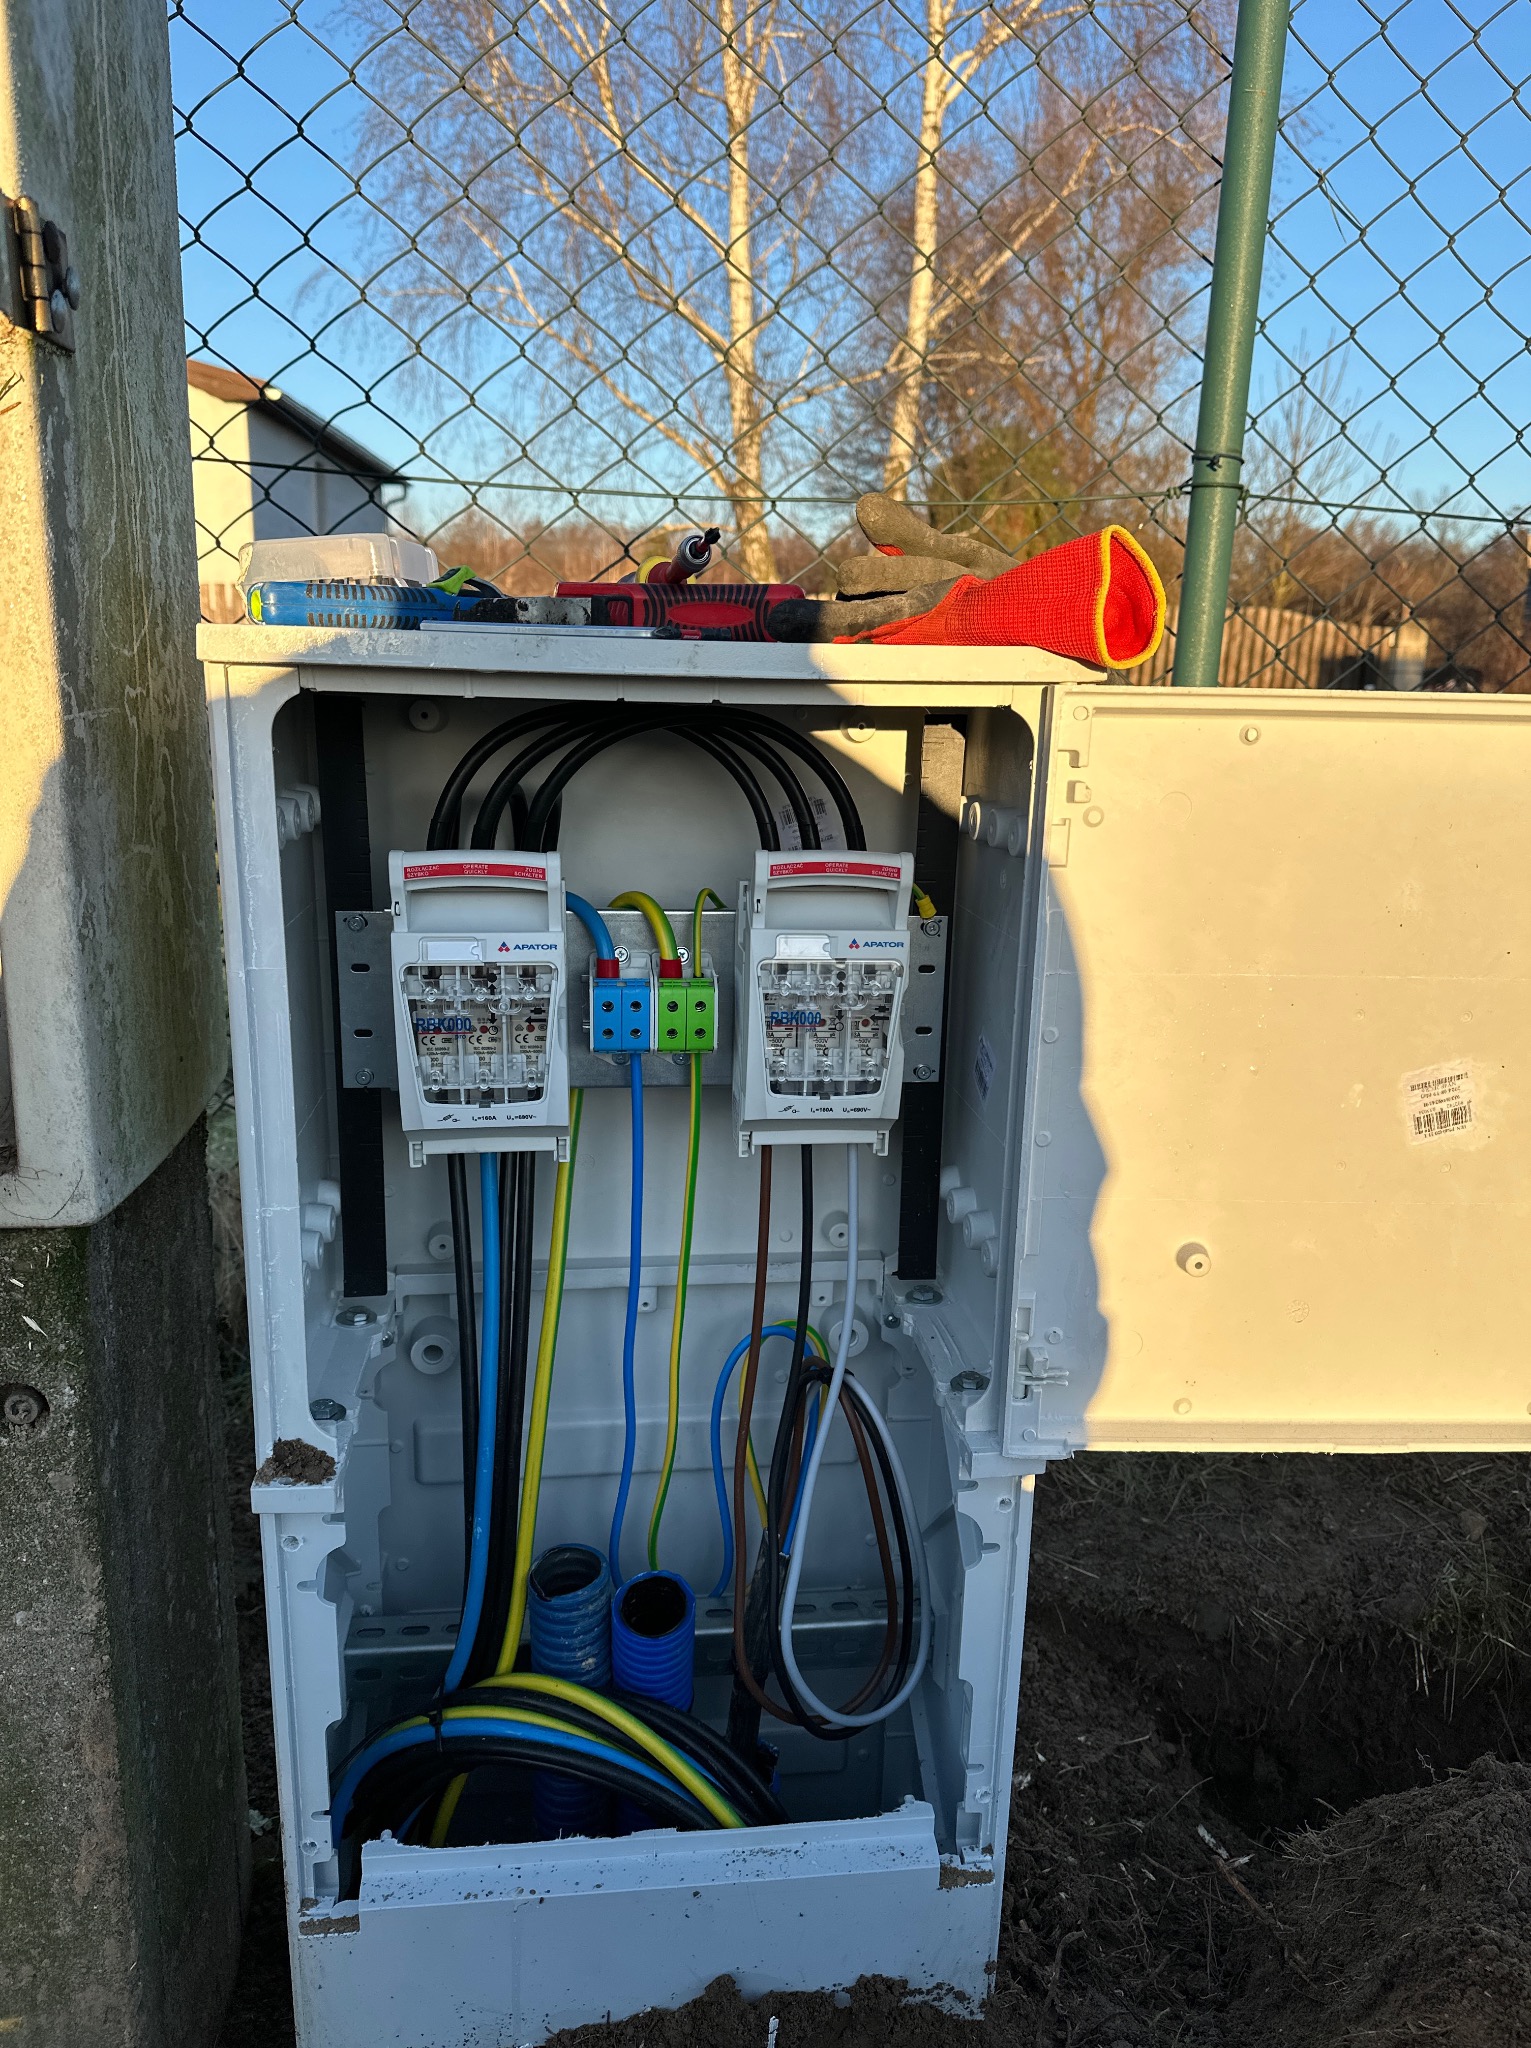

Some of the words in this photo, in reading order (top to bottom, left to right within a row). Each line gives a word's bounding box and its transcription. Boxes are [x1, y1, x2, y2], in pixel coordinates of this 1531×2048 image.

[514, 871, 543, 879] SCHALTEN
[871, 870, 898, 878] SCHALTEN
[513, 943, 558, 951] APATOR
[771, 1011, 822, 1025] RBK000
[416, 1017, 472, 1031] RBK000
